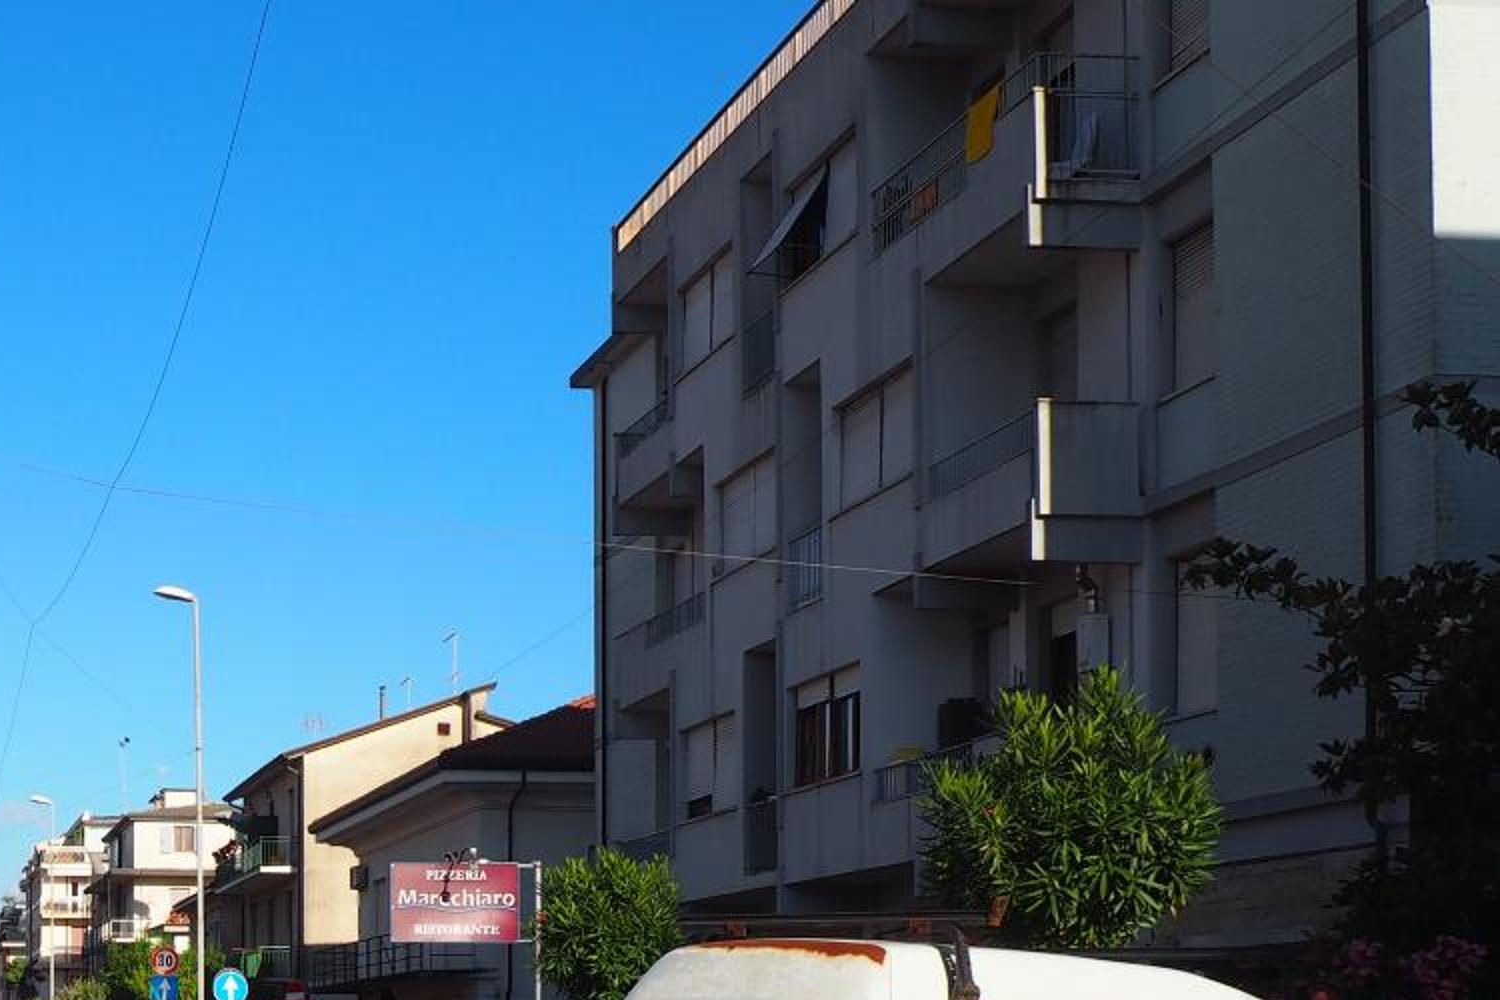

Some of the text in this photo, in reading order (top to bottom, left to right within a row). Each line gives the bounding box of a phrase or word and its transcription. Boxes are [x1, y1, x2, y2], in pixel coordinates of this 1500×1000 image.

[425, 869, 487, 881] PIZZERIA
[414, 923, 501, 935] RISTORANTE
[158, 953, 173, 967] 30
